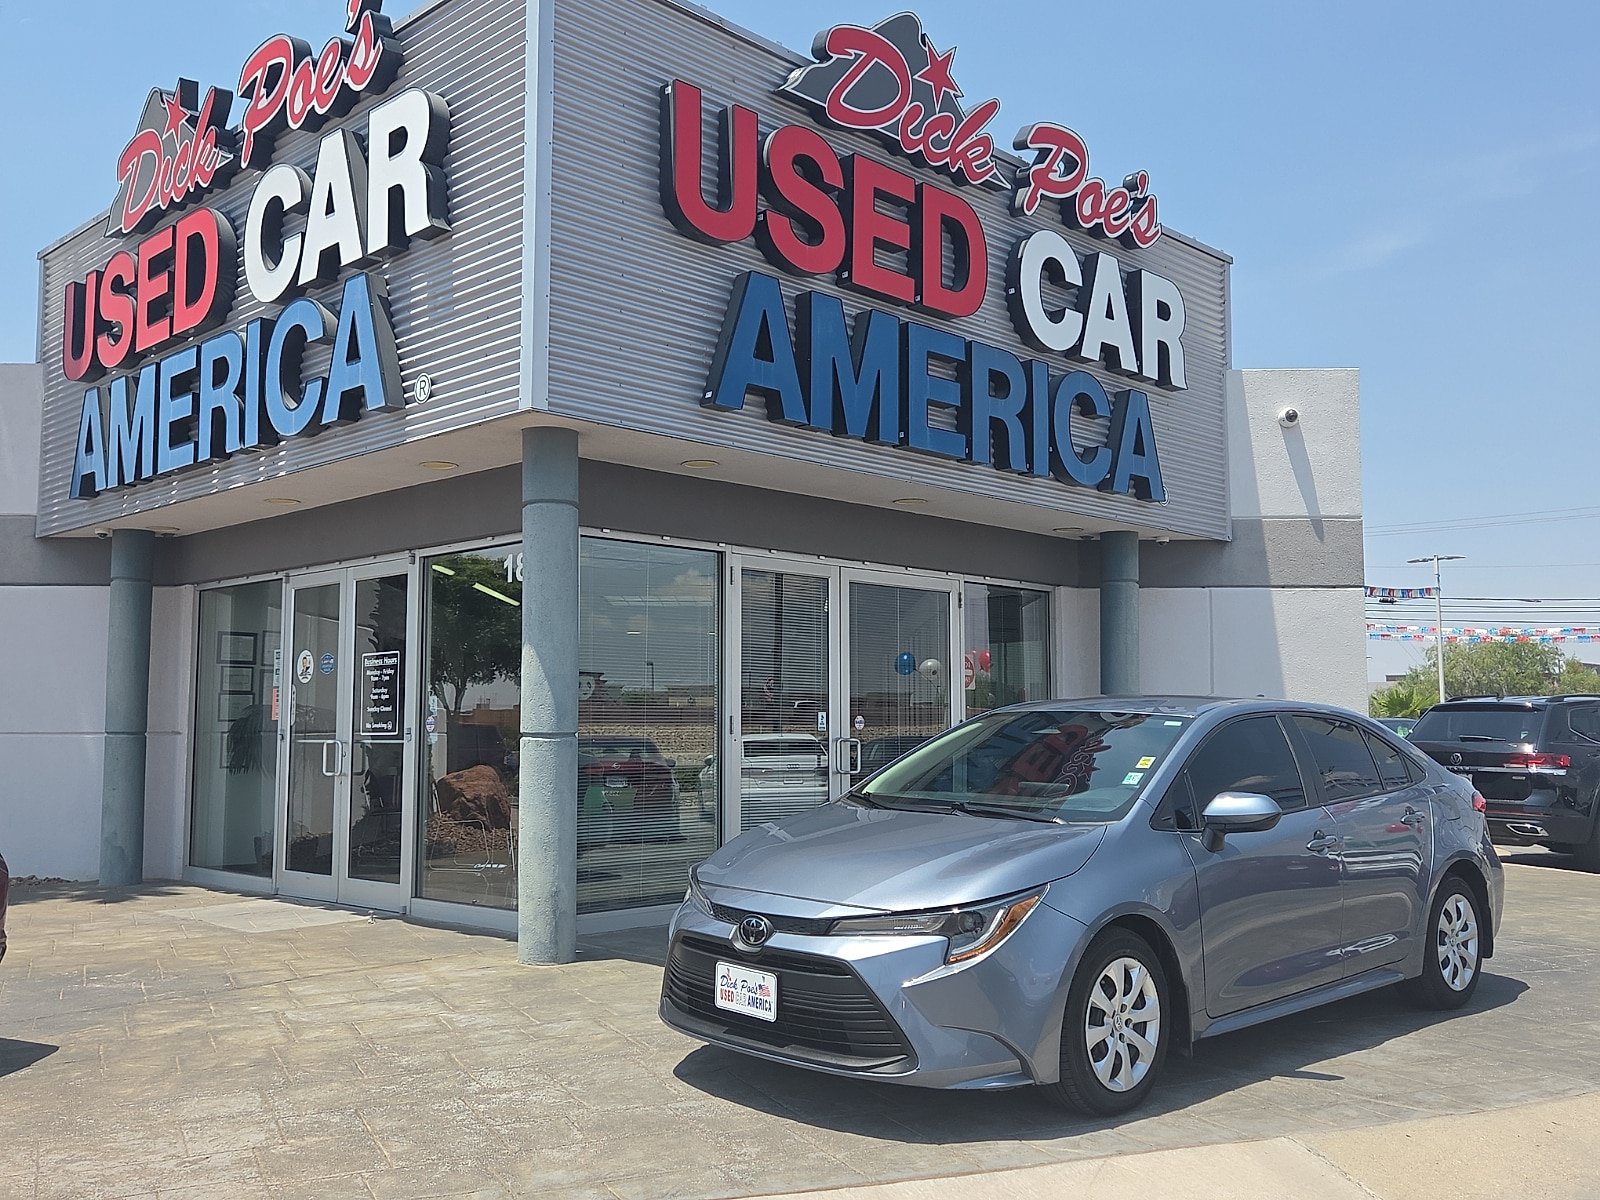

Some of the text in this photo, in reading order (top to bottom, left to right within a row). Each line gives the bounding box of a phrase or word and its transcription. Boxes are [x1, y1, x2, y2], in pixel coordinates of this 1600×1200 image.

[118, 0, 384, 233] Dick Poe's
[826, 24, 1162, 249] Dick Poe's
[63, 87, 433, 382] USED CAR
[671, 79, 1187, 390] USED CAR
[69, 272, 388, 500] AMERICA
[712, 271, 1165, 502] AMERICA
[720, 974, 738, 990] Dick
[720, 988, 735, 1003] USED
[747, 994, 773, 1013] AMERICA
